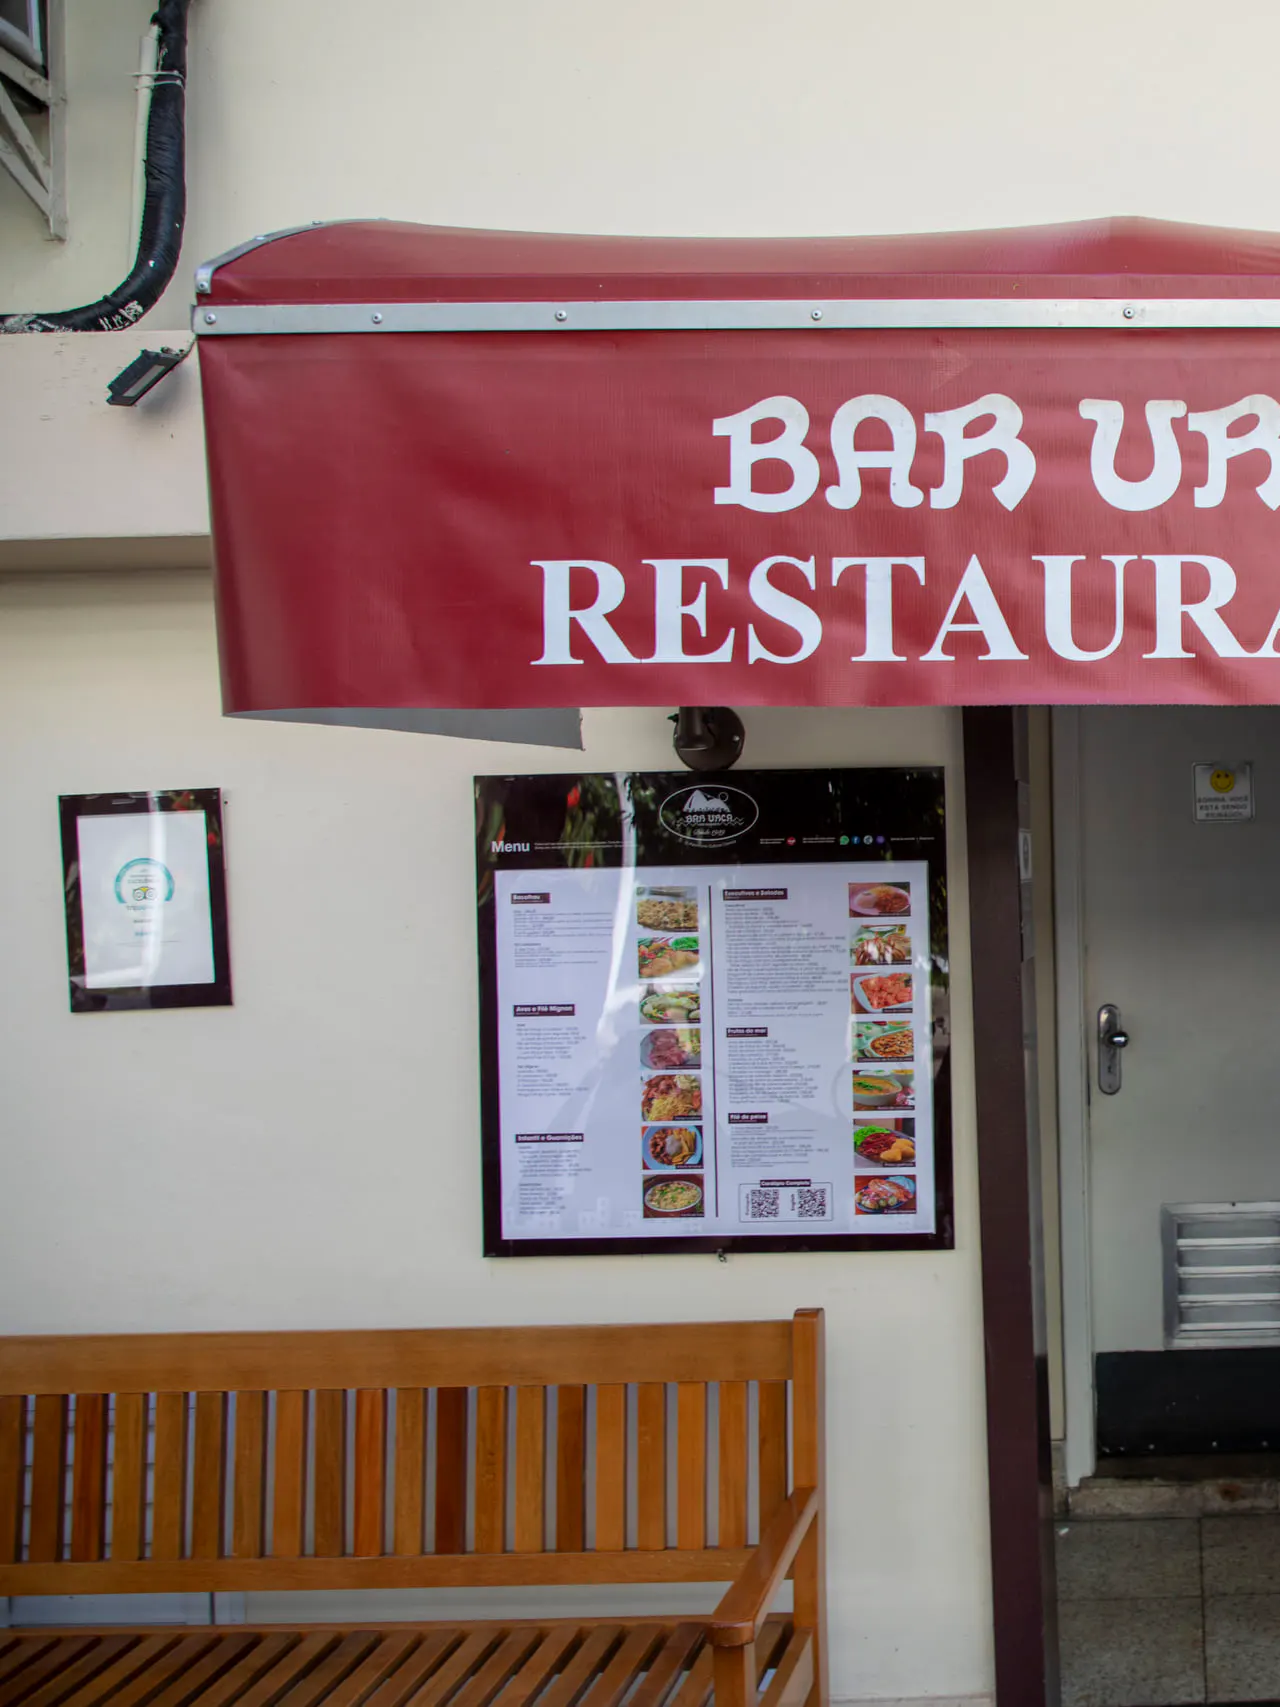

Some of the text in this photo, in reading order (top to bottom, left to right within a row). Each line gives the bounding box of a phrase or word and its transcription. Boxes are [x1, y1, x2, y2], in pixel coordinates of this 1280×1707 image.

[713, 392, 1036, 513] BAR
[685, 813, 733, 823] BAR URCA
[491, 840, 530, 853] Menu
[549, 1005, 573, 1014] Mignon
